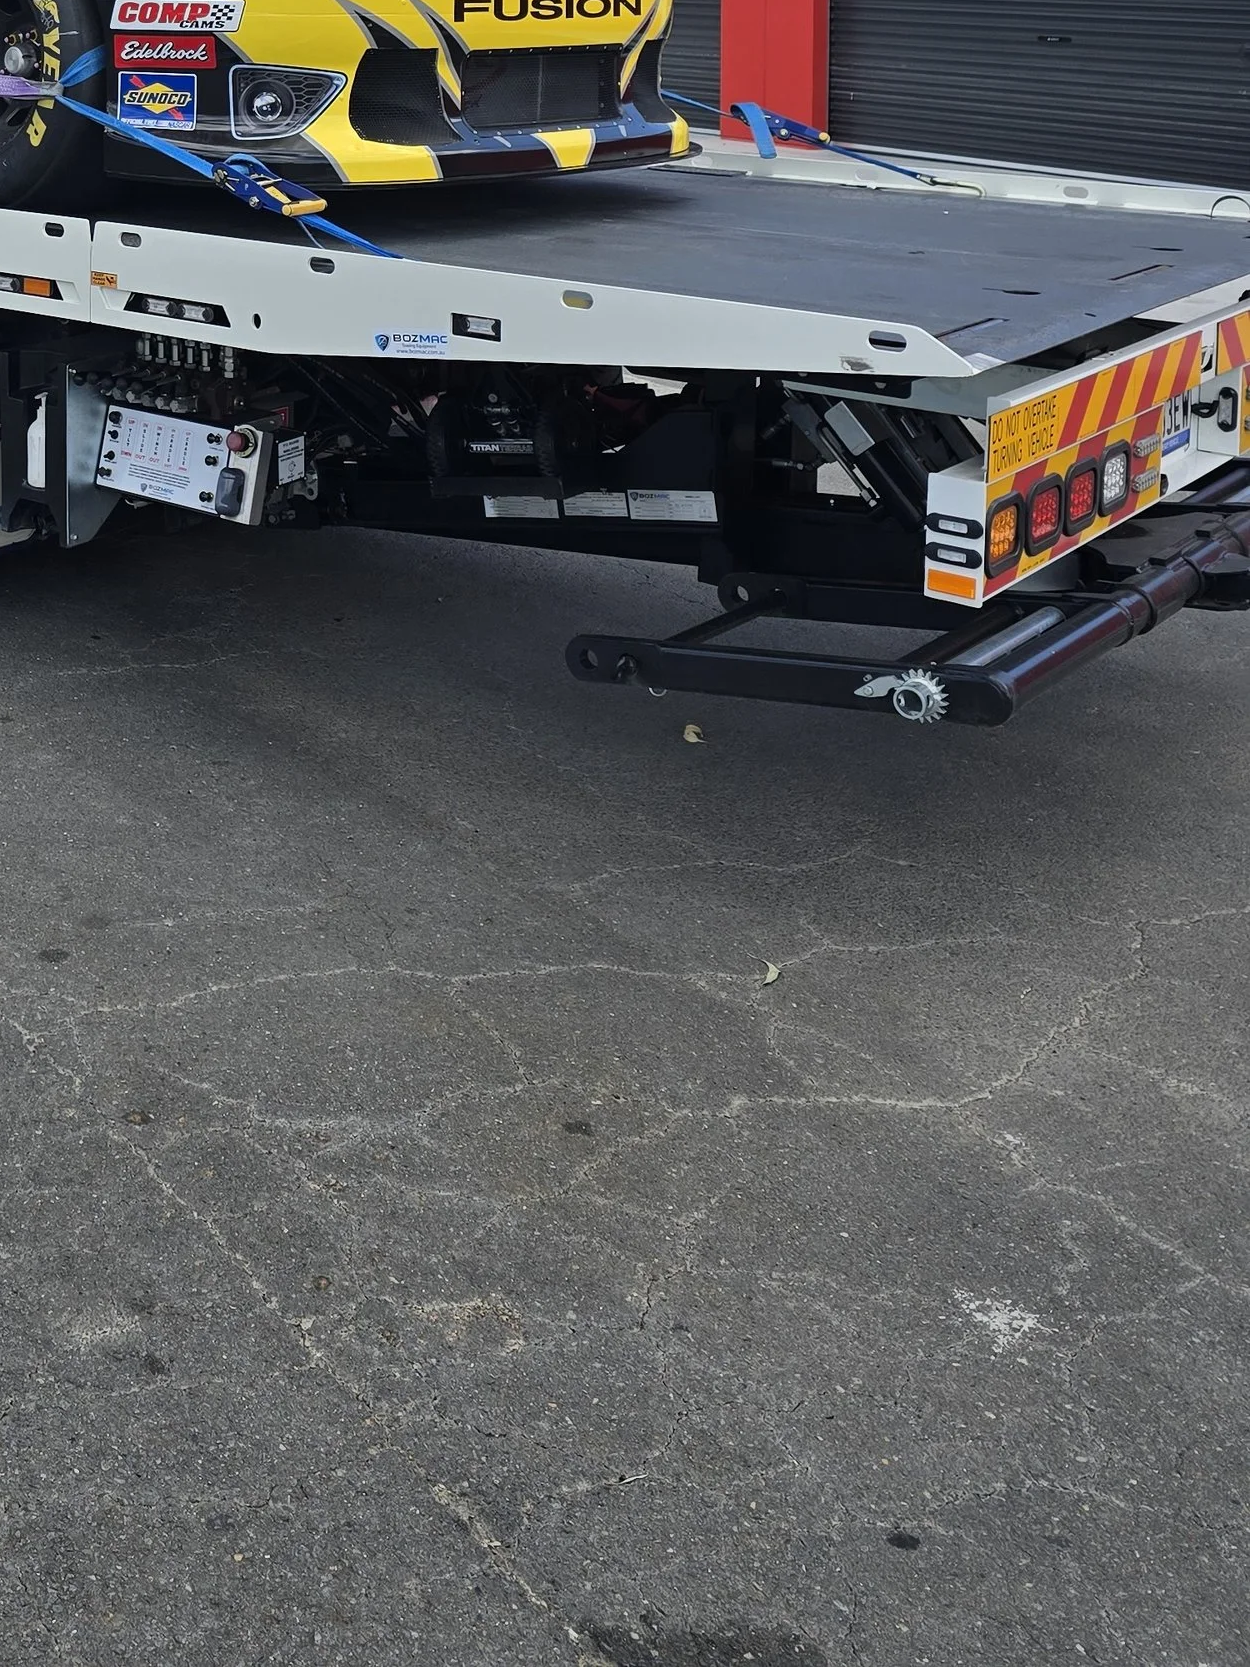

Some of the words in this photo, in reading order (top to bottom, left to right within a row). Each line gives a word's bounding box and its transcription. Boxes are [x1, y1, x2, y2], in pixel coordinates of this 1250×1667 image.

[118, 2, 211, 24] COMP
[179, 20, 225, 29] CAMS
[120, 40, 208, 61] Edelbrock
[126, 91, 189, 106] SUNOCO
[393, 334, 448, 344] BOZMAC
[992, 418, 1003, 444] DO
[1006, 410, 1021, 439] NOT
[1023, 395, 1057, 431] OVERTAKE
[470, 444, 500, 452] TITAN
[993, 438, 1023, 474] TURNING
[1027, 424, 1055, 457] VEHICLE
